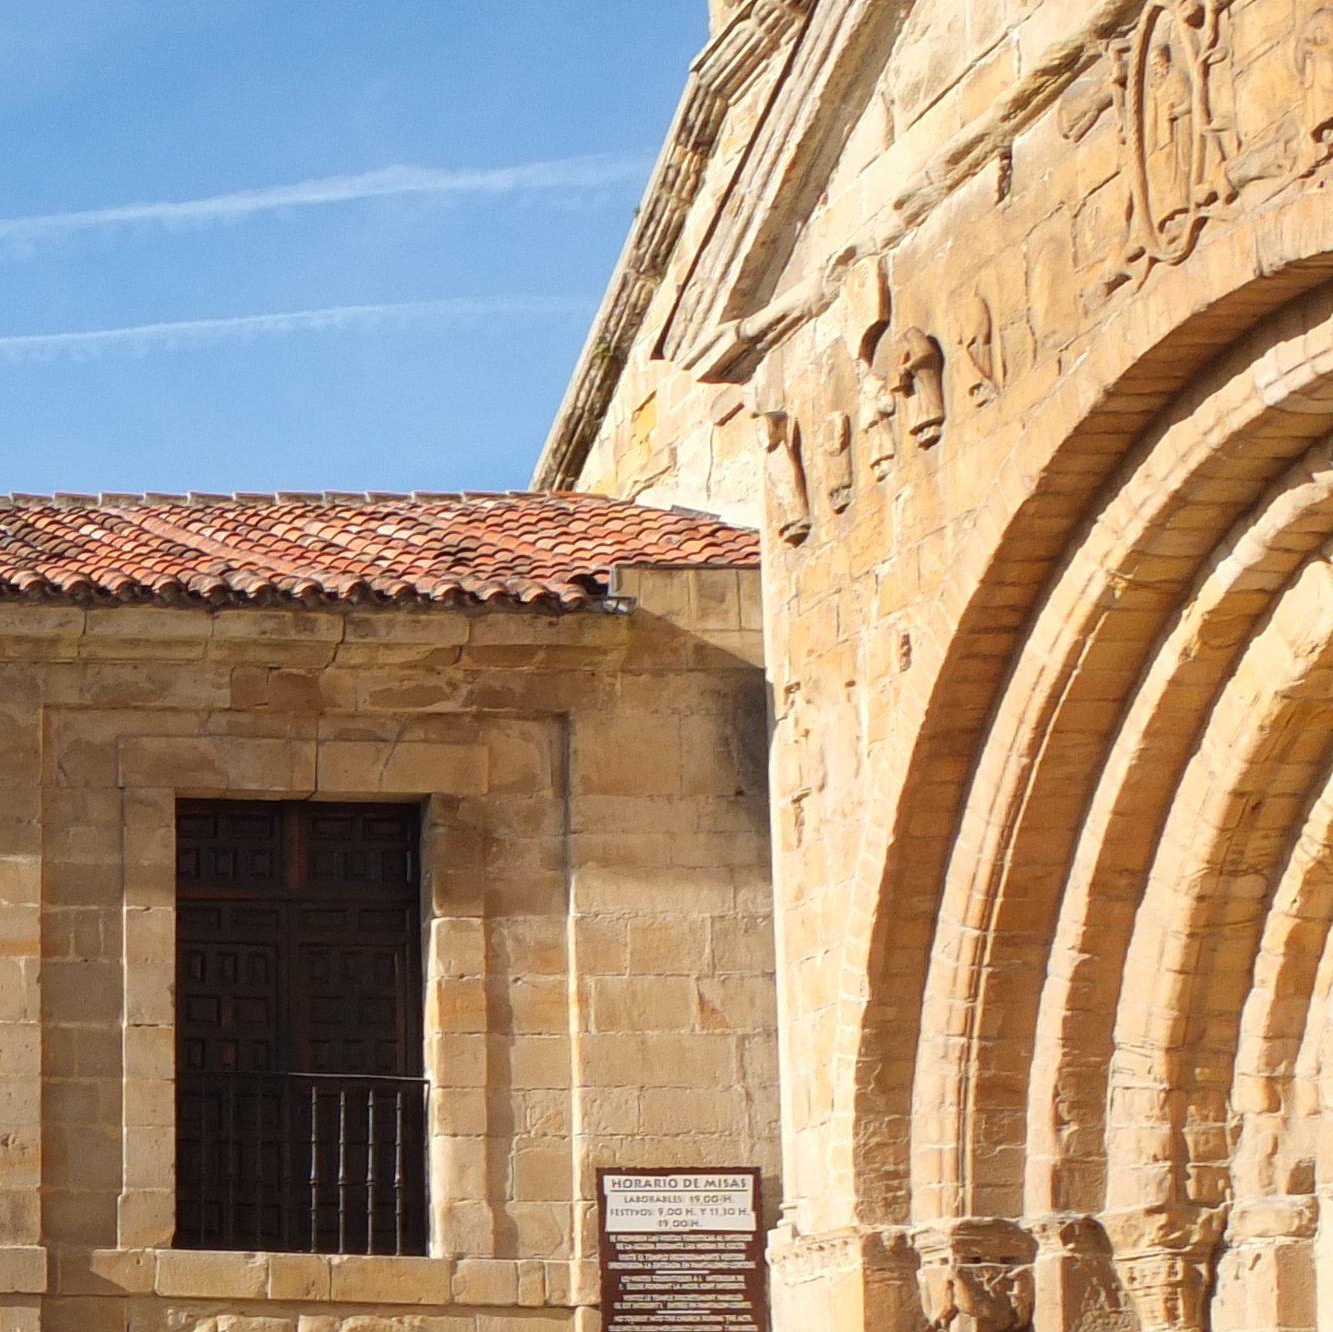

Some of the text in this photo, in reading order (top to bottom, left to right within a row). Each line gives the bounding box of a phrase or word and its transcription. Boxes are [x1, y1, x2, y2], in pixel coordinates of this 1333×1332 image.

[611, 1178, 747, 1188] HORARIO DE MISAS
[700, 1208, 707, 1216] Y
